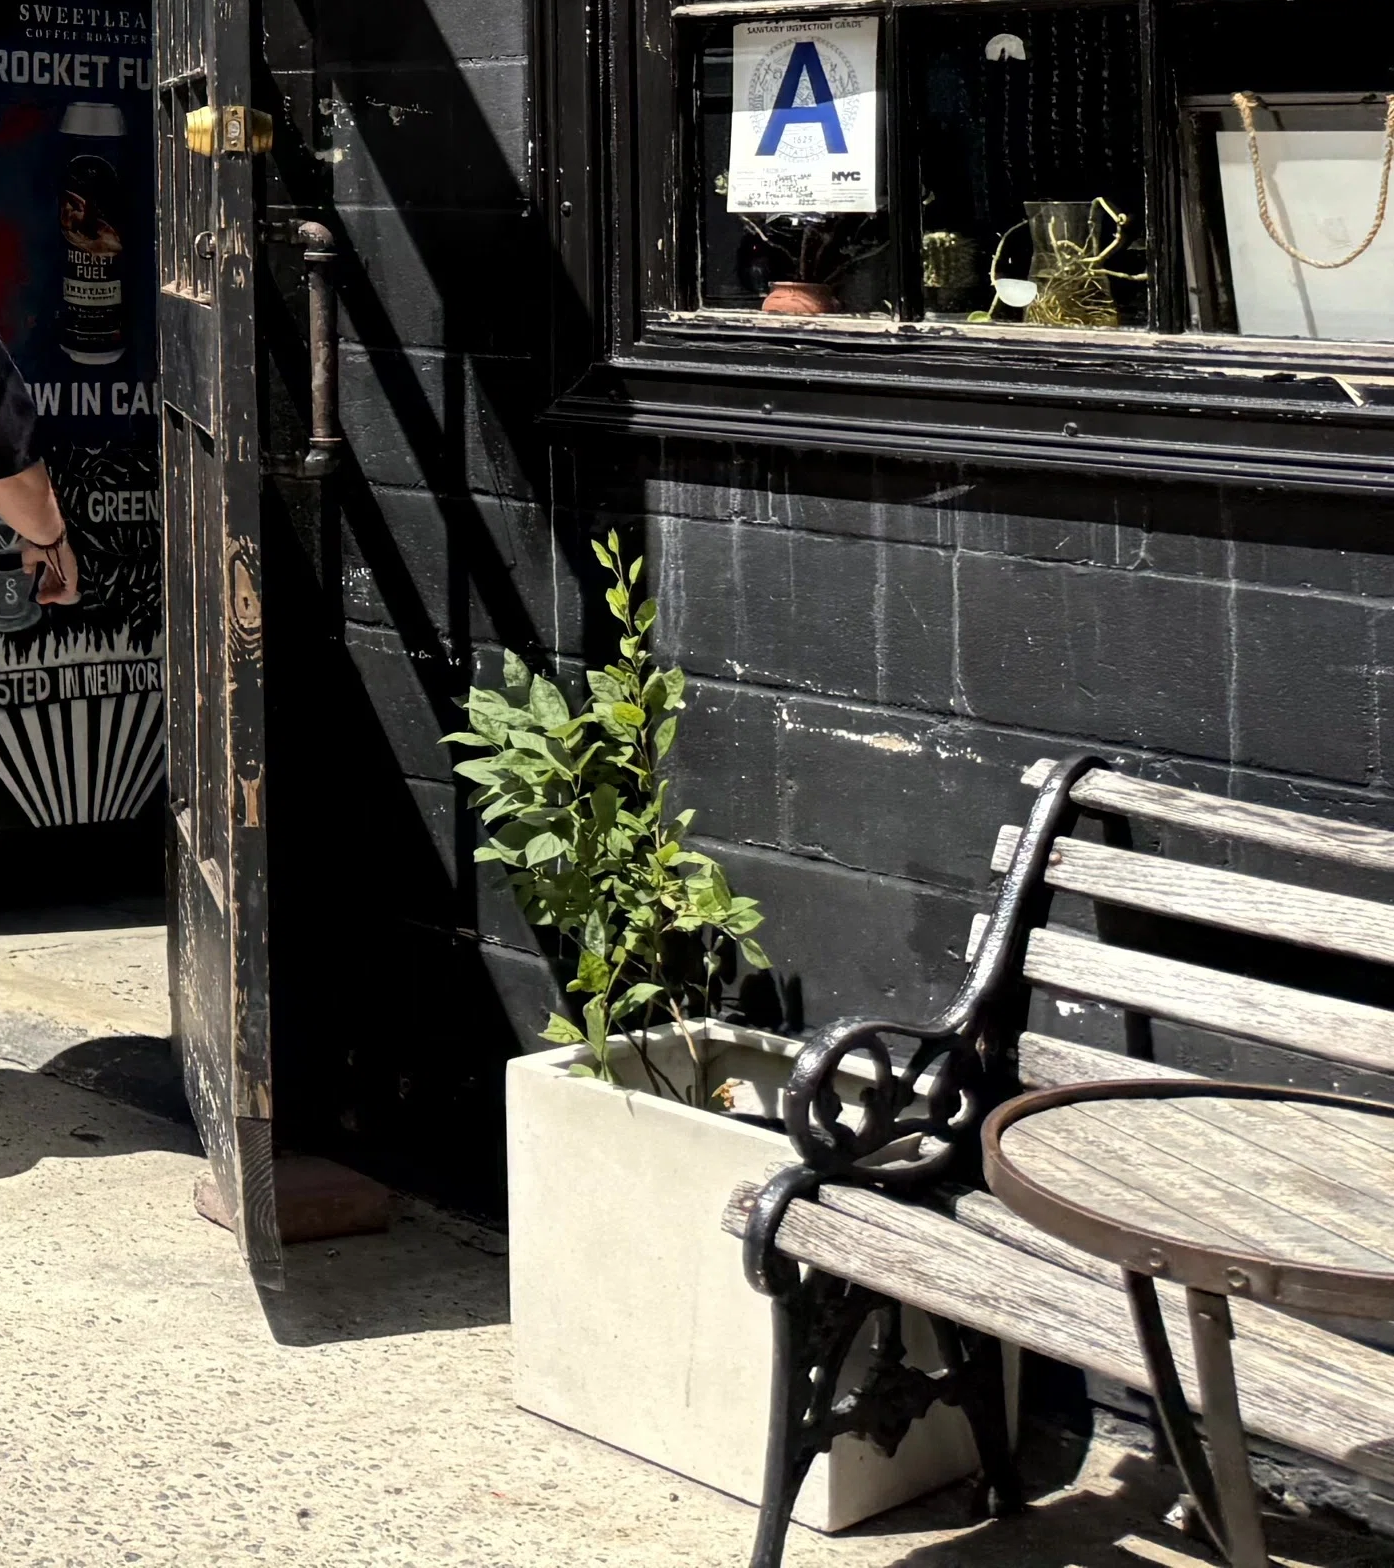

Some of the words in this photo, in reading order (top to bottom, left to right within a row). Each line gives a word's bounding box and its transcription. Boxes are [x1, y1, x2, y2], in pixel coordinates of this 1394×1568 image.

[19, 3, 147, 29] SWEETLEA
[87, 32, 148, 44] ROASTER
[118, 57, 153, 91] FU
[755, 41, 849, 156] A
[831, 171, 861, 182] NYC
[76, 265, 107, 279] FUEL
[71, 382, 101, 416] IN
[112, 382, 159, 416] CA
[58, 666, 80, 699] IN
[83, 663, 122, 697] NEW
[125, 662, 163, 692] YOR
